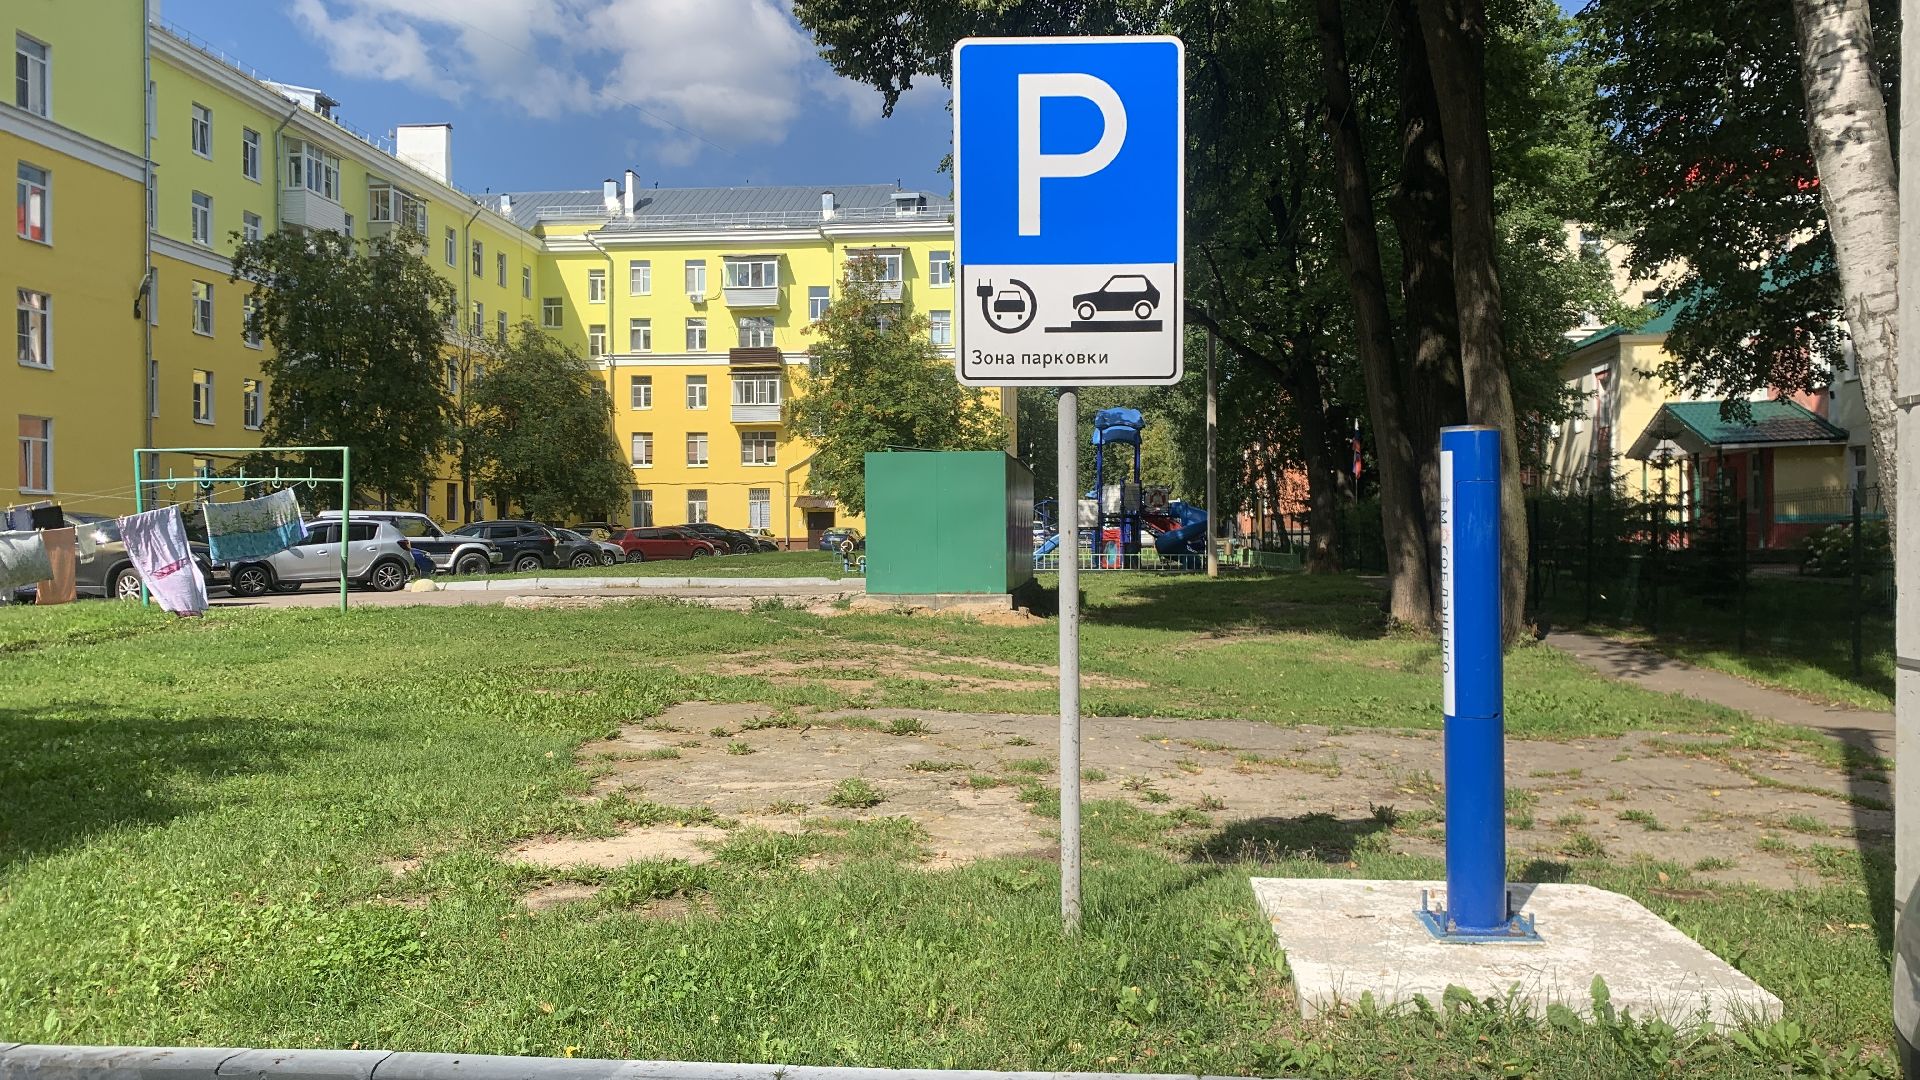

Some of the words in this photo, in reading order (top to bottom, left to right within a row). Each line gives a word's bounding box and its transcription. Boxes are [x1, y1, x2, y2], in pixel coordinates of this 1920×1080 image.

[1018, 73, 1127, 236] P
[972, 349, 1015, 365] Зона
[1021, 352, 1109, 369] парковки
